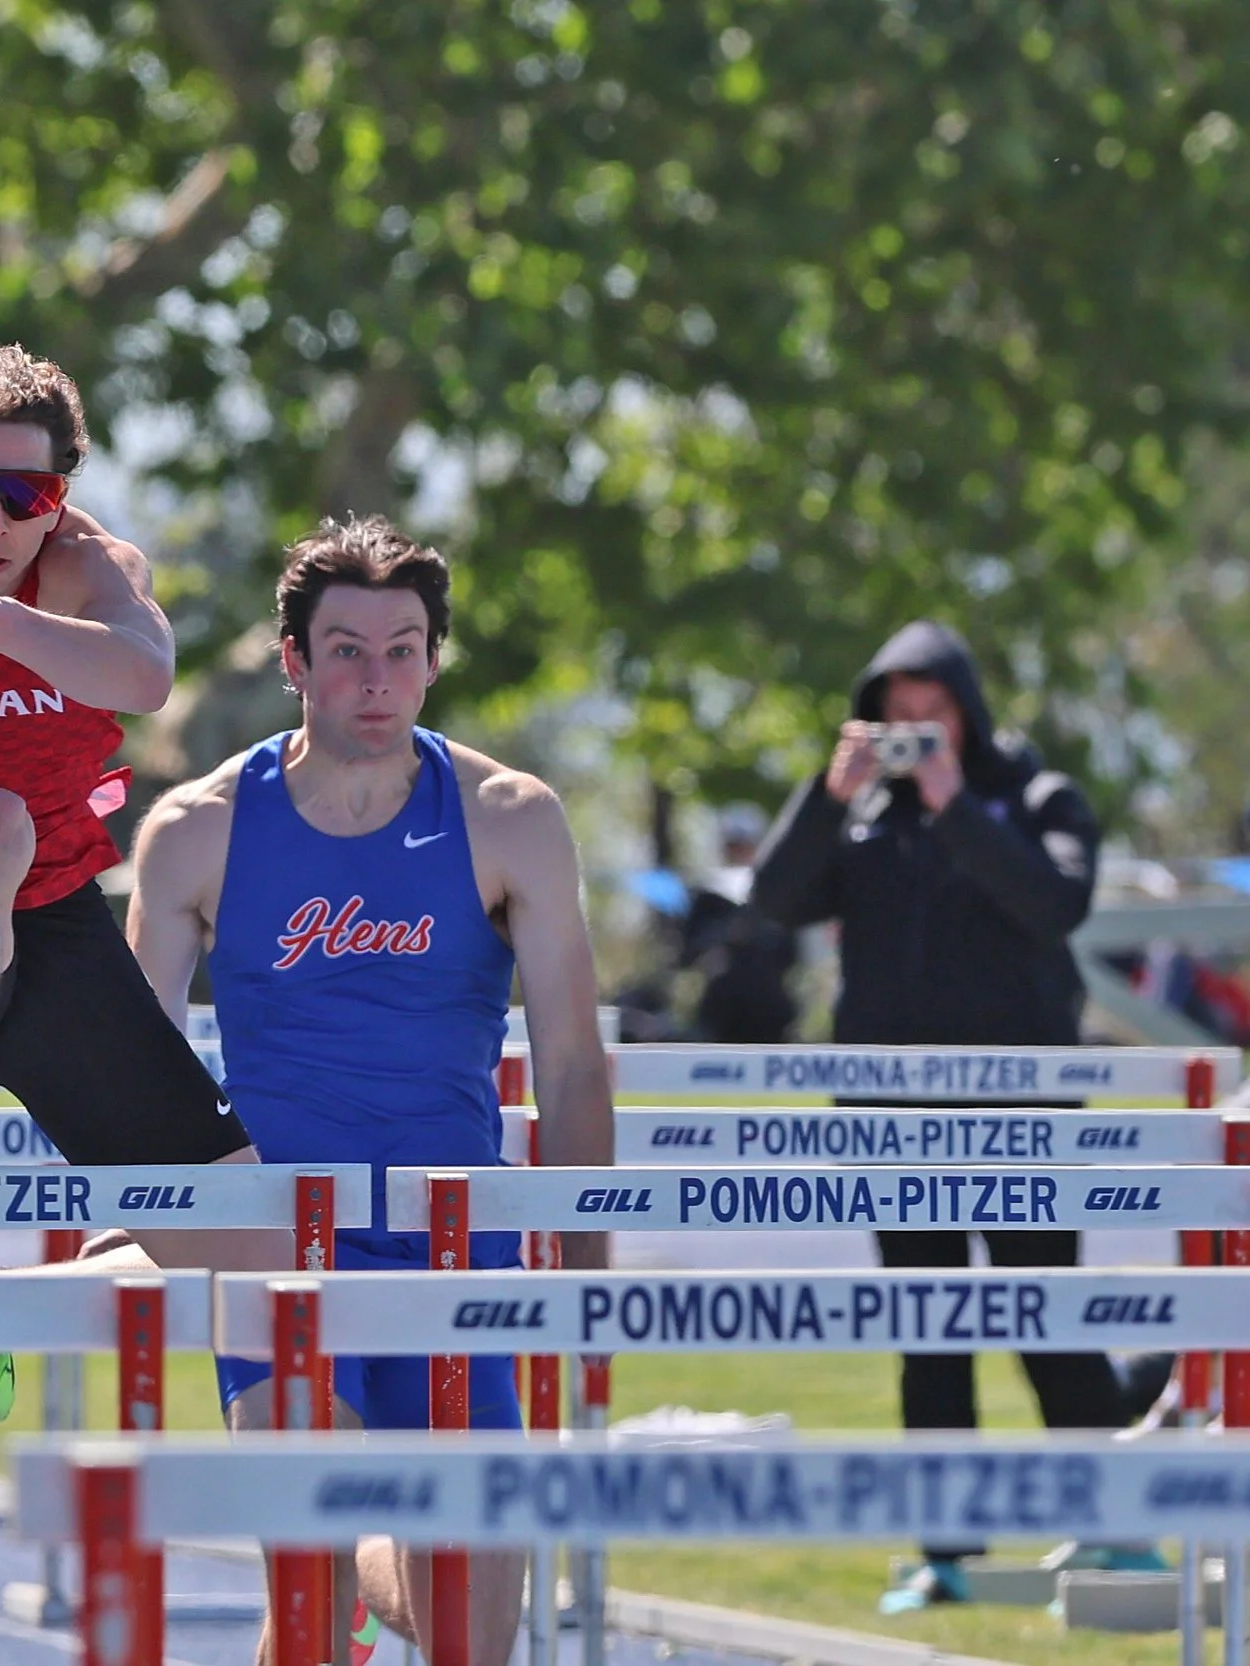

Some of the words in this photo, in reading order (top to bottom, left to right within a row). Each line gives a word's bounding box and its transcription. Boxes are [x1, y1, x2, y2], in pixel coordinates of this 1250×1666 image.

[272, 895, 434, 970] Hens
[764, 1056, 1038, 1091] POMONA-PITZER
[652, 1127, 713, 1146] GILL
[738, 1119, 1052, 1156] POMONA-PITZER
[1077, 1128, 1139, 1149] GILL
[119, 1186, 195, 1209] GILL
[576, 1189, 652, 1212] GILL
[680, 1176, 1056, 1223] POMONA-PITZER
[1085, 1187, 1160, 1210] GILL
[453, 1301, 544, 1329] GILL
[582, 1284, 1046, 1340] POMONA-PITZER
[1082, 1296, 1173, 1324] GILL
[484, 1455, 1099, 1528] POMONA-PITZER
